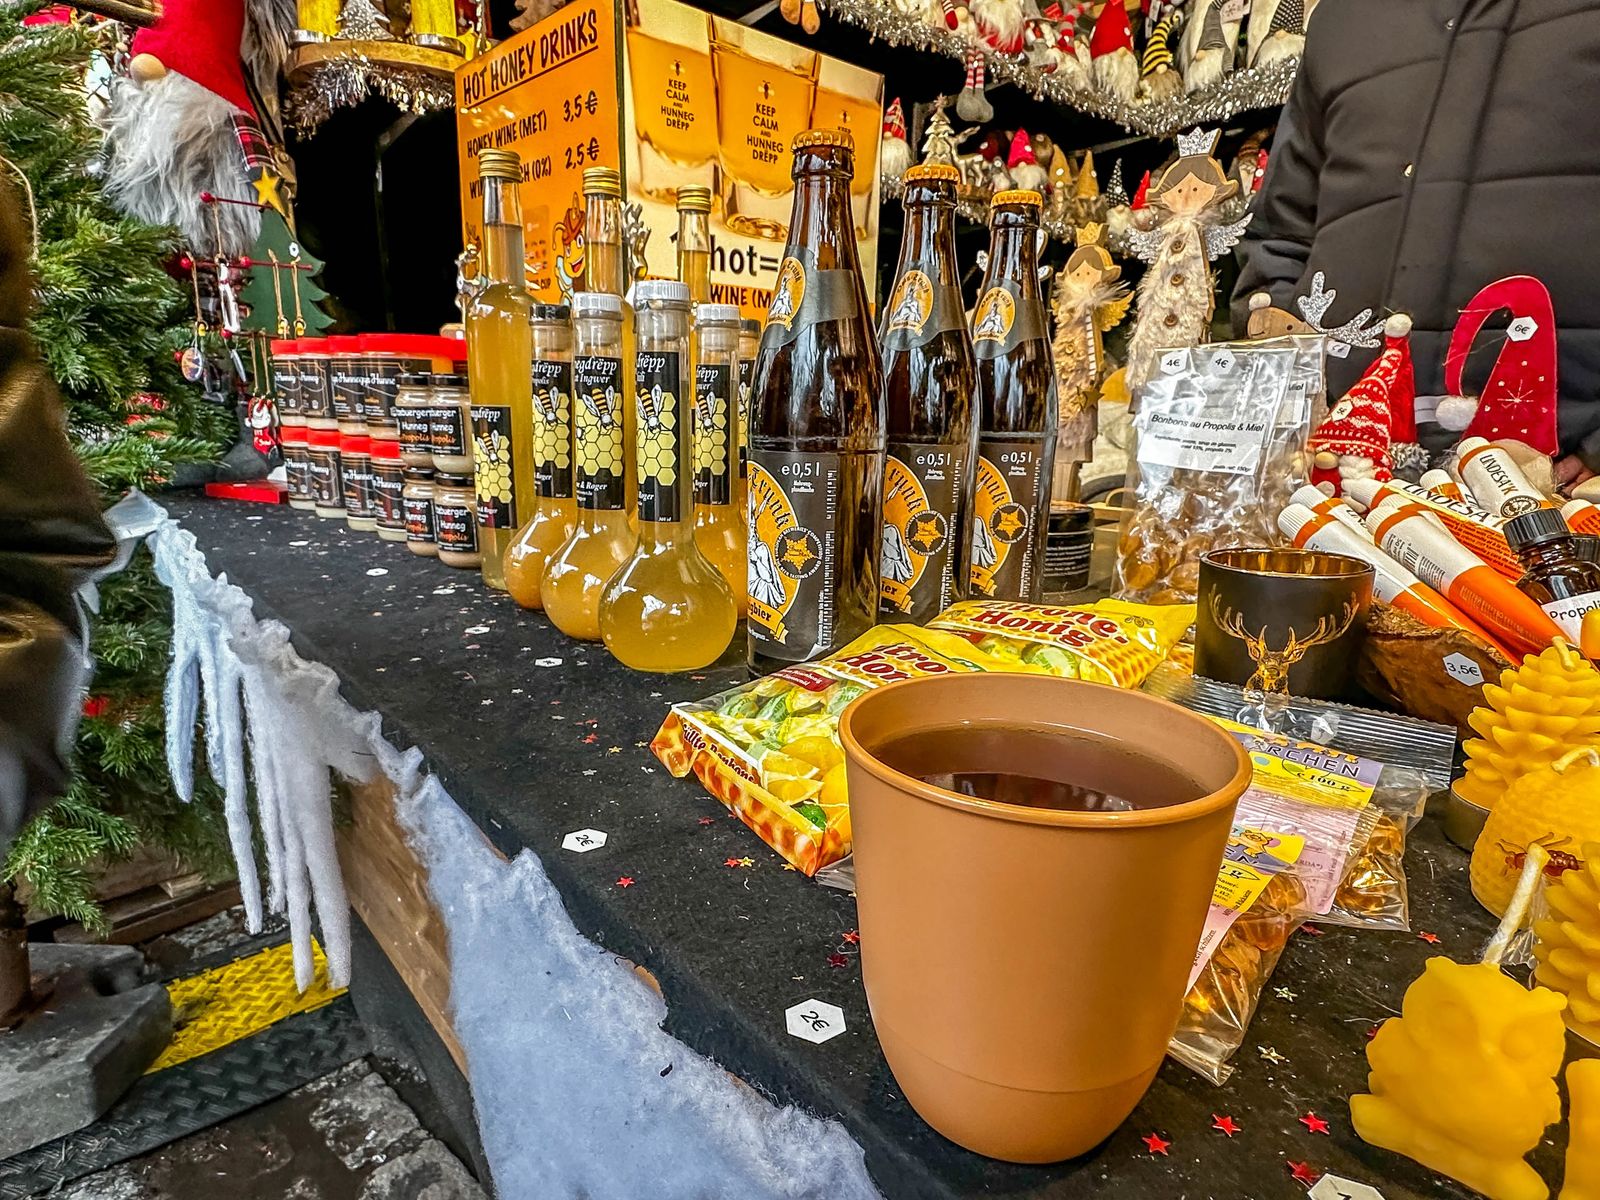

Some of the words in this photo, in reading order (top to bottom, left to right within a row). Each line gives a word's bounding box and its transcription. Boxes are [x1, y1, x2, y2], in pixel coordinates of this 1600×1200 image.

[463, 66, 487, 105] HOT
[491, 40, 536, 92] HONEY
[540, 9, 598, 68] DRINKS
[668, 79, 687, 91] KEEP
[666, 89, 690, 104] CALM
[660, 105, 695, 122] HUNNEG
[756, 102, 776, 117] KEEP
[666, 117, 690, 131] DRËPP
[752, 115, 779, 132] CALM
[467, 131, 493, 158] HONEY
[495, 122, 517, 147] WINE
[519, 109, 547, 139] (MET)
[760, 130, 772, 138] AND
[746, 134, 784, 154] HUNNEG
[752, 149, 778, 165] DRËPP
[532, 155, 551, 181] (0%)
[710, 234, 779, 277] hot=
[710, 284, 747, 306] WINE
[1515, 324, 1530, 334] 6€
[1166, 359, 1180, 367] 4€
[1215, 358, 1229, 368] 4€
[580, 374, 610, 386] Ingwer
[1151, 415, 1189, 428] Bonbons
[1202, 421, 1236, 432] Propolis
[1237, 423, 1244, 431] &
[1245, 423, 1265, 432] Miel
[929, 453, 945, 468] 0,5
[1010, 452, 1026, 466] 0,5
[792, 462, 812, 478] 0,5
[586, 482, 607, 491] Roger
[888, 467, 922, 513] runk
[969, 610, 1095, 647] Honig
[1448, 662, 1479, 677] 3,5€
[1267, 744, 1360, 778] RCHEN
[1309, 773, 1336, 788] 100
[575, 834, 594, 847] 2€
[801, 1010, 830, 1033] 2€
